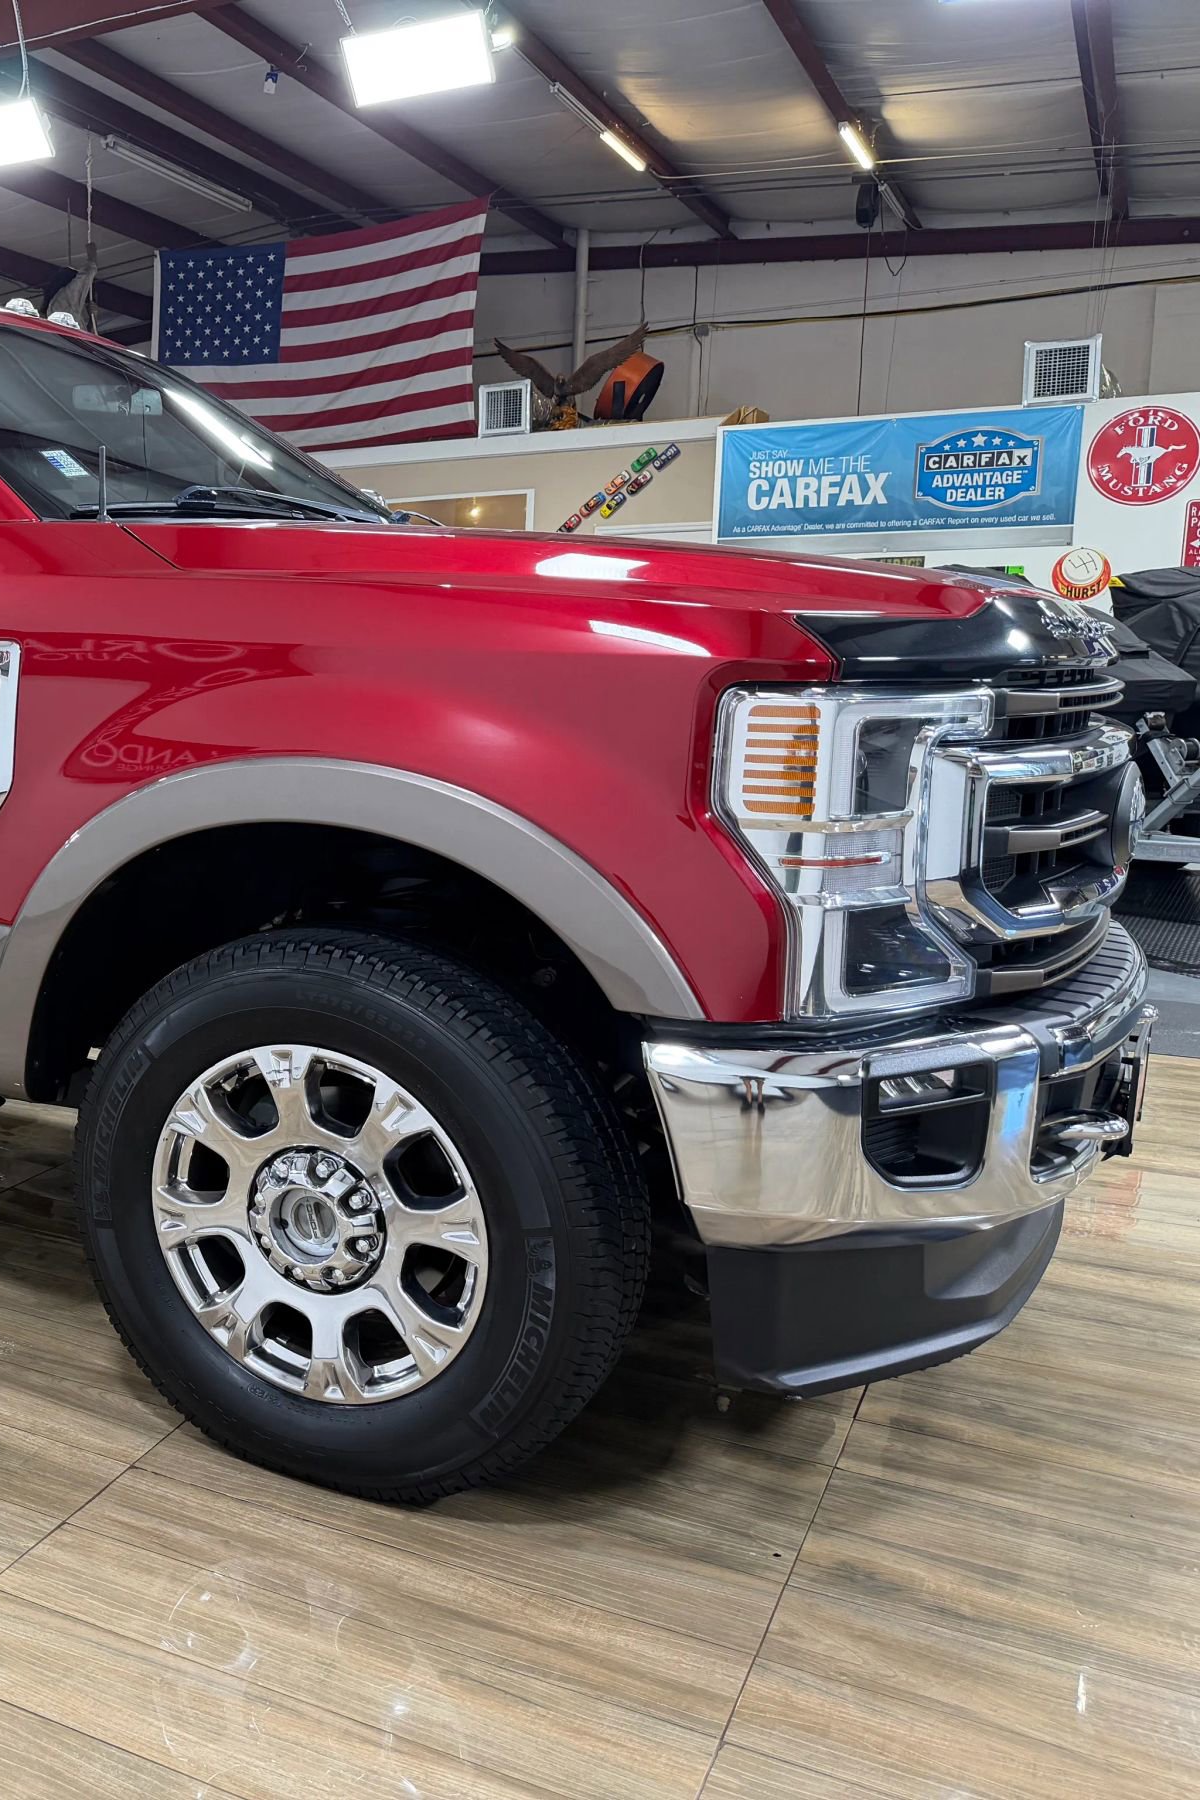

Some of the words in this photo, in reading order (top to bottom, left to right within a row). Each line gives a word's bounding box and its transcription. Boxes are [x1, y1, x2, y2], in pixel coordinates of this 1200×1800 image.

[1114, 415, 1179, 435] FORD
[749, 450, 770, 460] JUST
[772, 449, 789, 459] SAY
[927, 451, 1029, 470] CARFAX
[749, 459, 804, 478] SHOW
[808, 457, 835, 475] ME
[839, 454, 872, 474] THE
[932, 470, 1022, 488] ADVANTAGE
[1098, 462, 1189, 496] MUSTANG
[747, 472, 889, 511] CARFAX
[946, 487, 1005, 502] DEALER
[747, 525, 770, 533] CARFAX
[804, 523, 824, 531] Dealer,
[847, 521, 879, 529] committed
[887, 518, 912, 528] offering
[919, 517, 946, 526] CARFAX
[947, 517, 969, 526] Report
[980, 516, 999, 525] every
[1000, 514, 1017, 523] used
[1042, 513, 1056, 521] sell.
[1065, 579, 1102, 598] HURST
[93, 1048, 145, 1186] MICHELIN
[479, 1281, 554, 1430] MICHELIN
